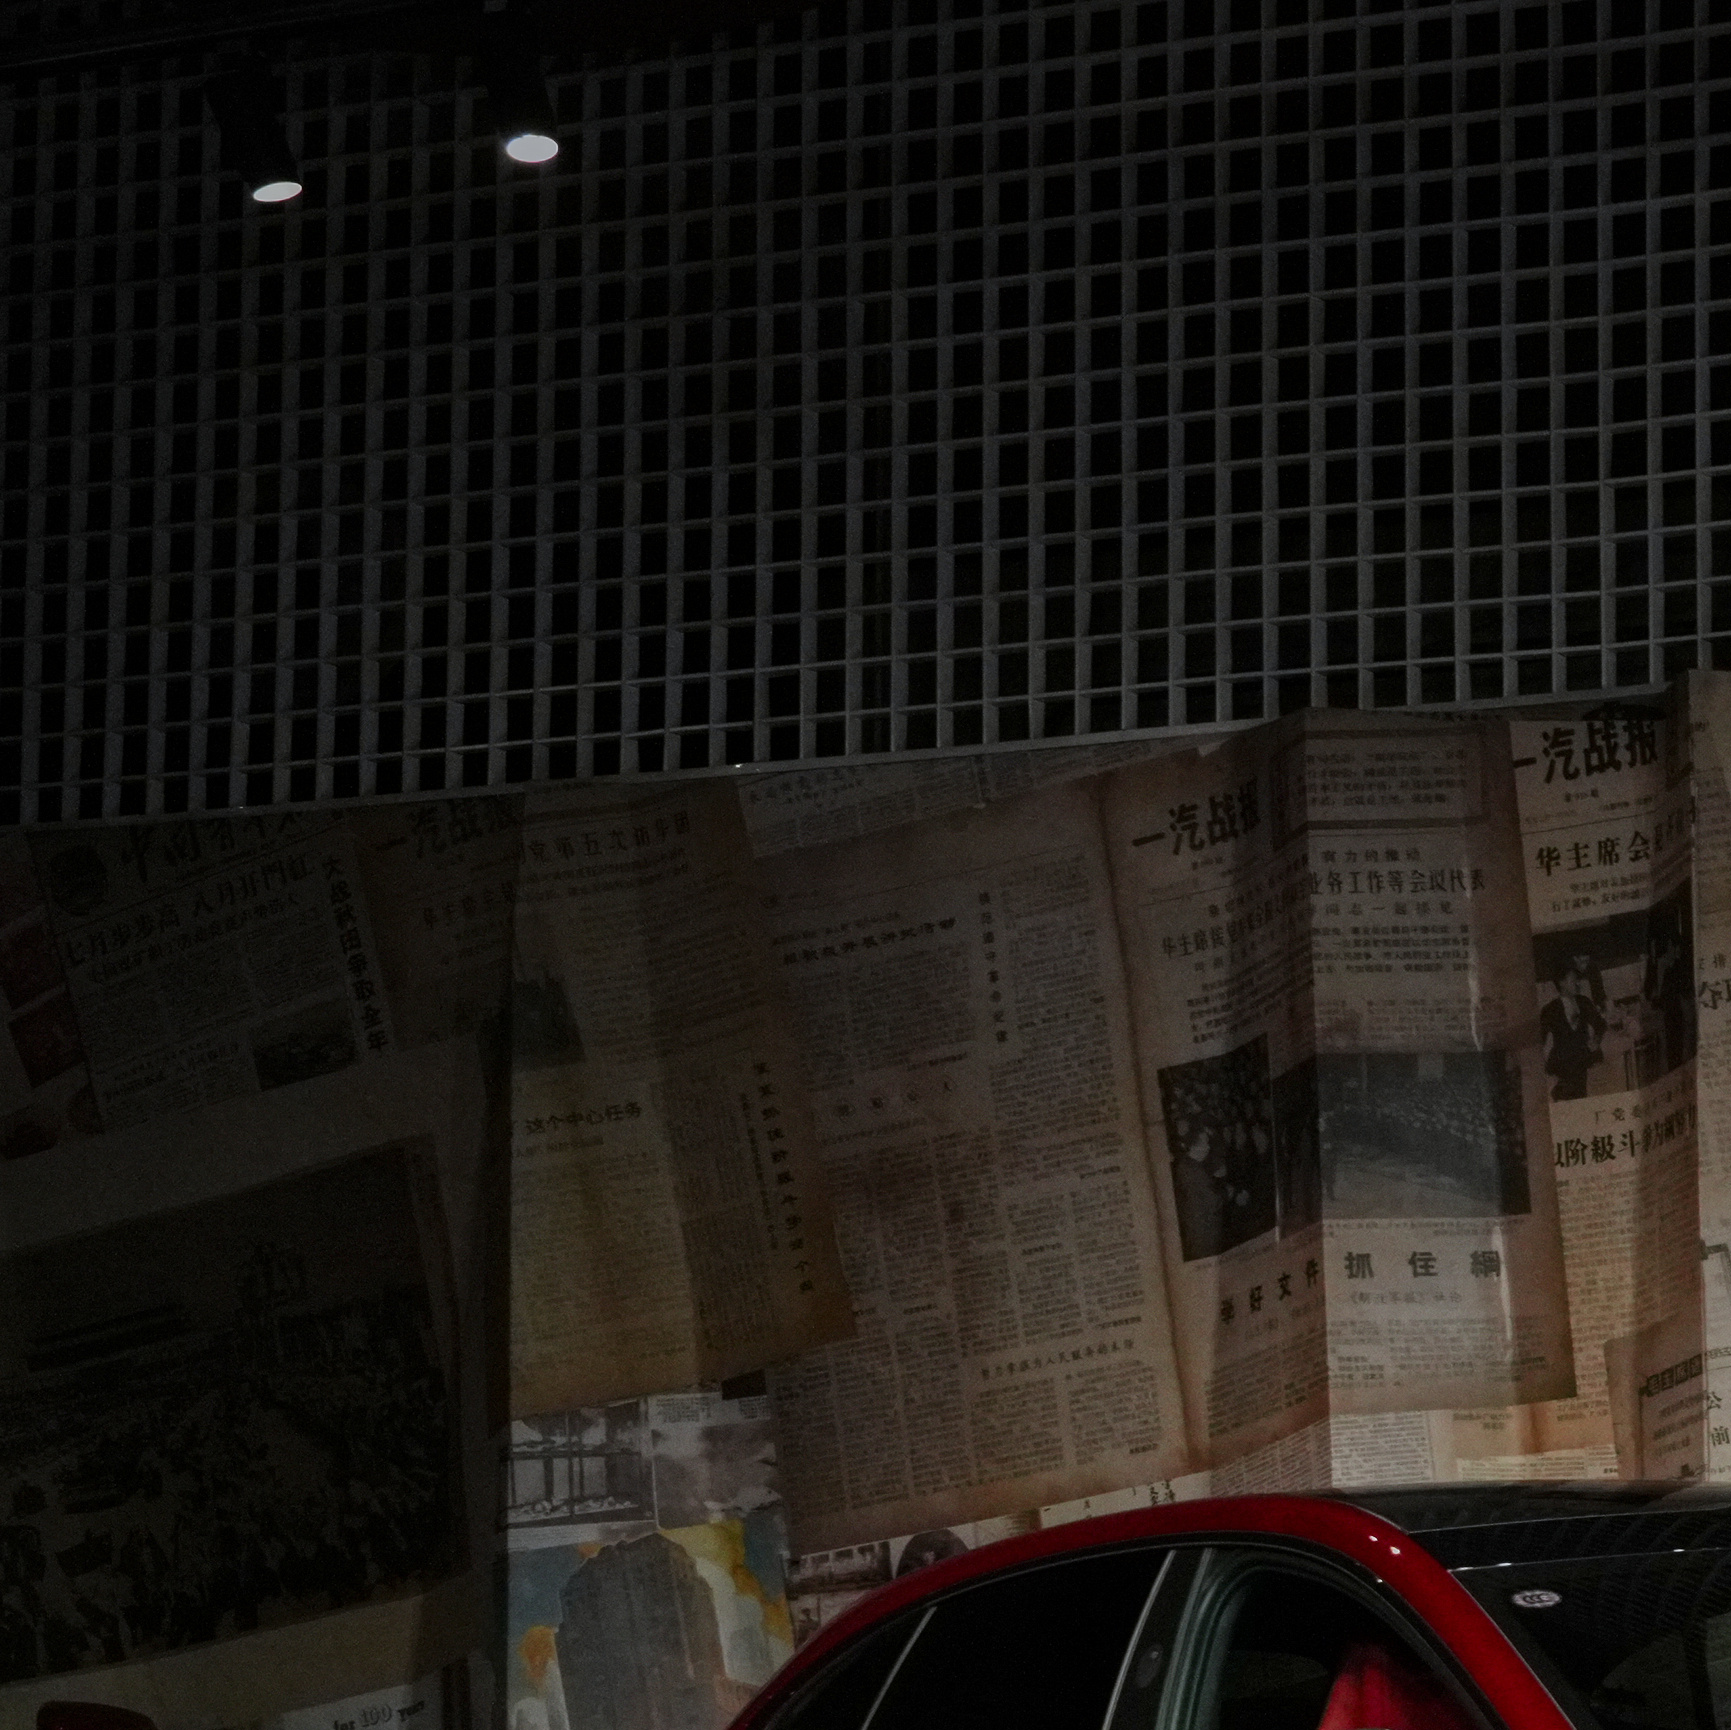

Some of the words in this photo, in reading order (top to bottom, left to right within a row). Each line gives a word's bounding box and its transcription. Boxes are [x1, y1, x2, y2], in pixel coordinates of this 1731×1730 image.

[1513, 718, 1658, 786] 一汽战报
[525, 1100, 643, 1135] 这个中心任务
